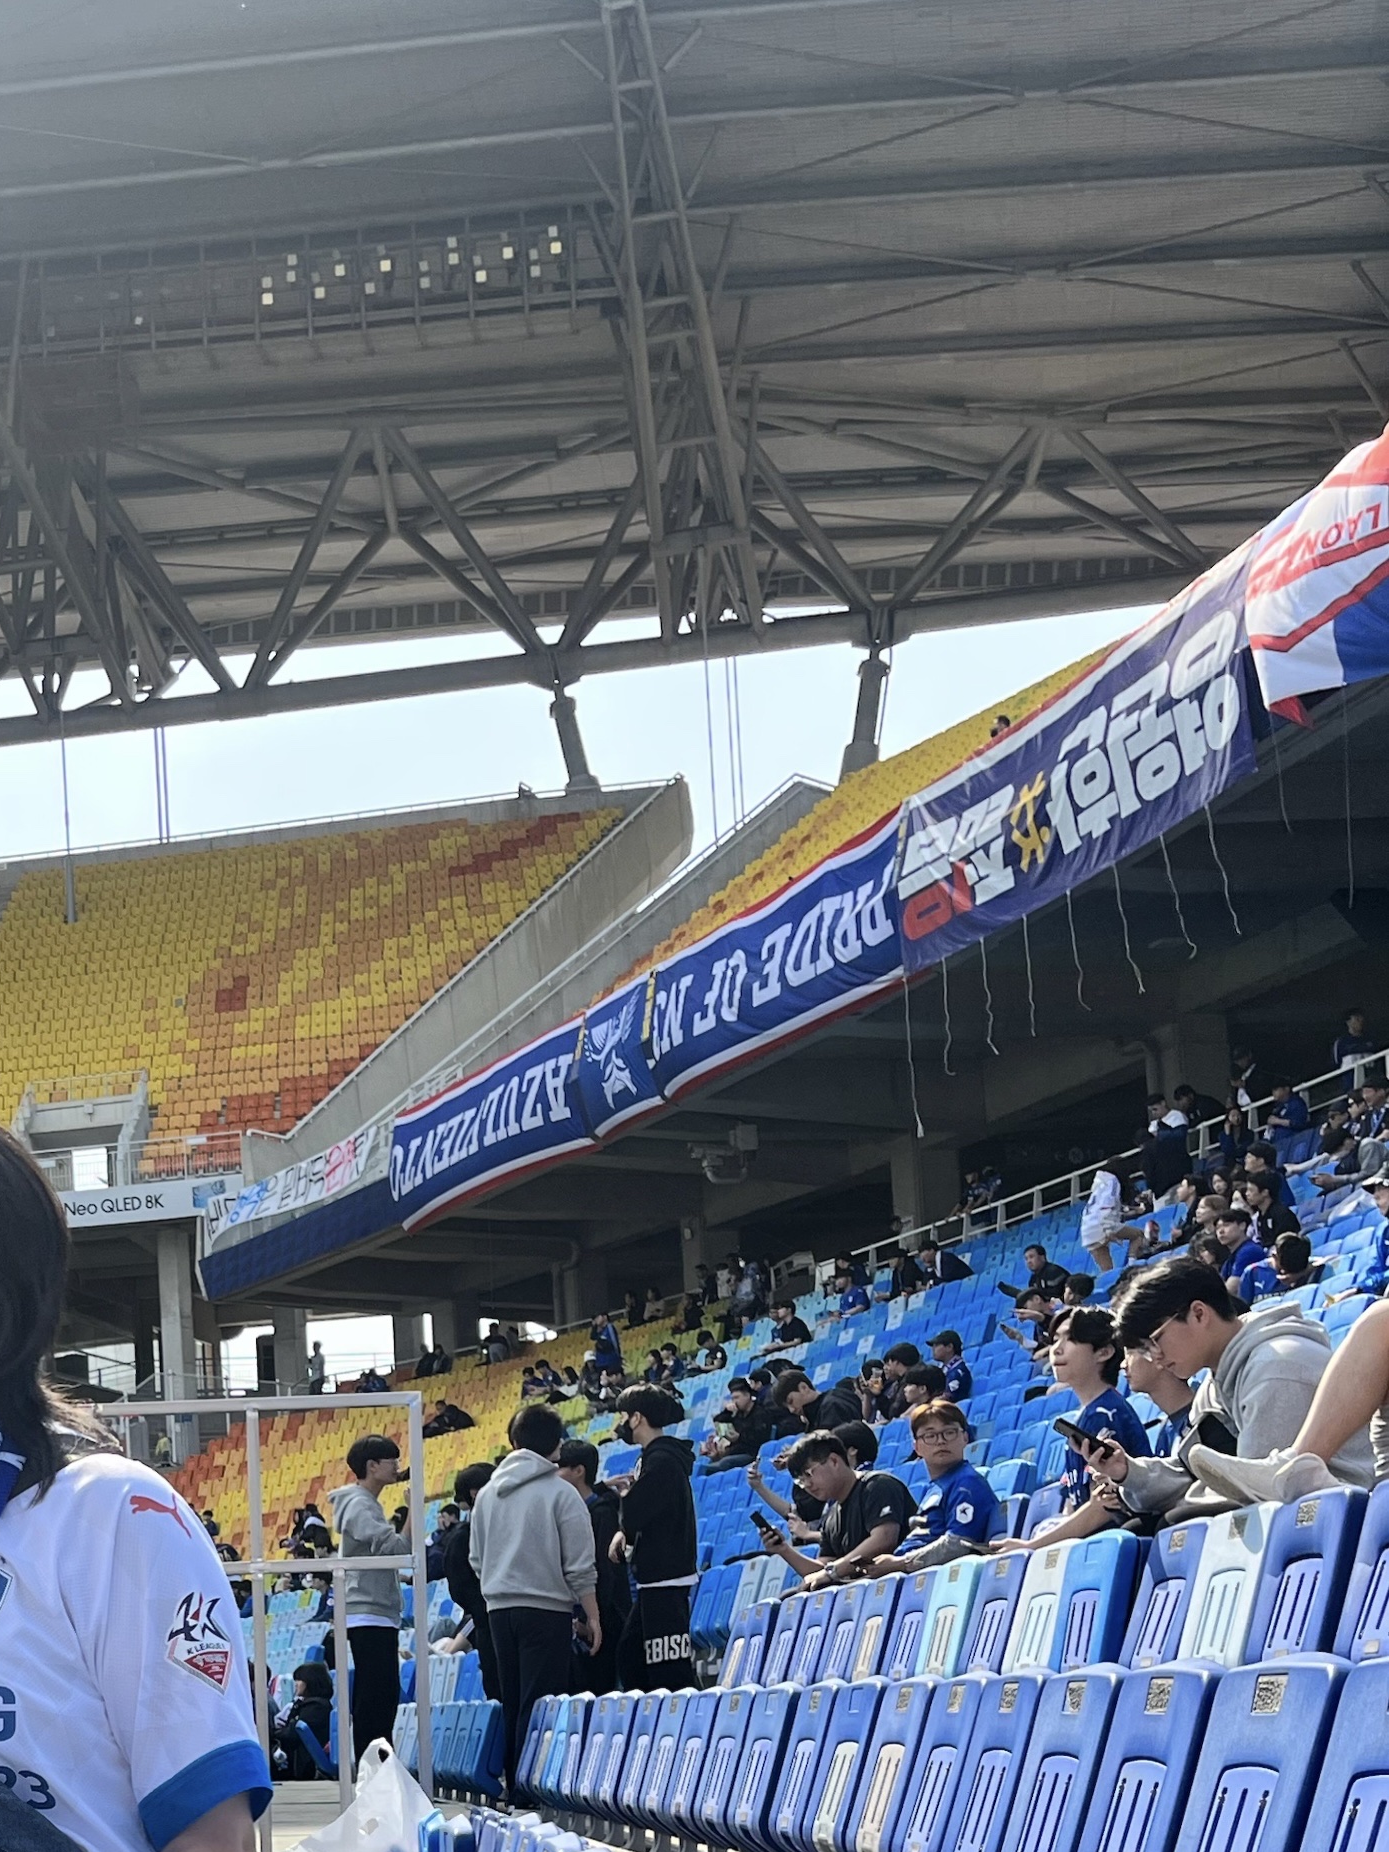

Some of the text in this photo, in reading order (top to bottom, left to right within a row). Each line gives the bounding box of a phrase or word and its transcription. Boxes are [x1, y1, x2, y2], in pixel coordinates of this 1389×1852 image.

[897, 609, 1239, 941] 영원한 젊음
[693, 950, 748, 1038] OF
[751, 864, 896, 1007] PRIDE
[388, 1052, 573, 1202] AZULVIENTO
[64, 1193, 164, 1216] Neo QLED 8K
